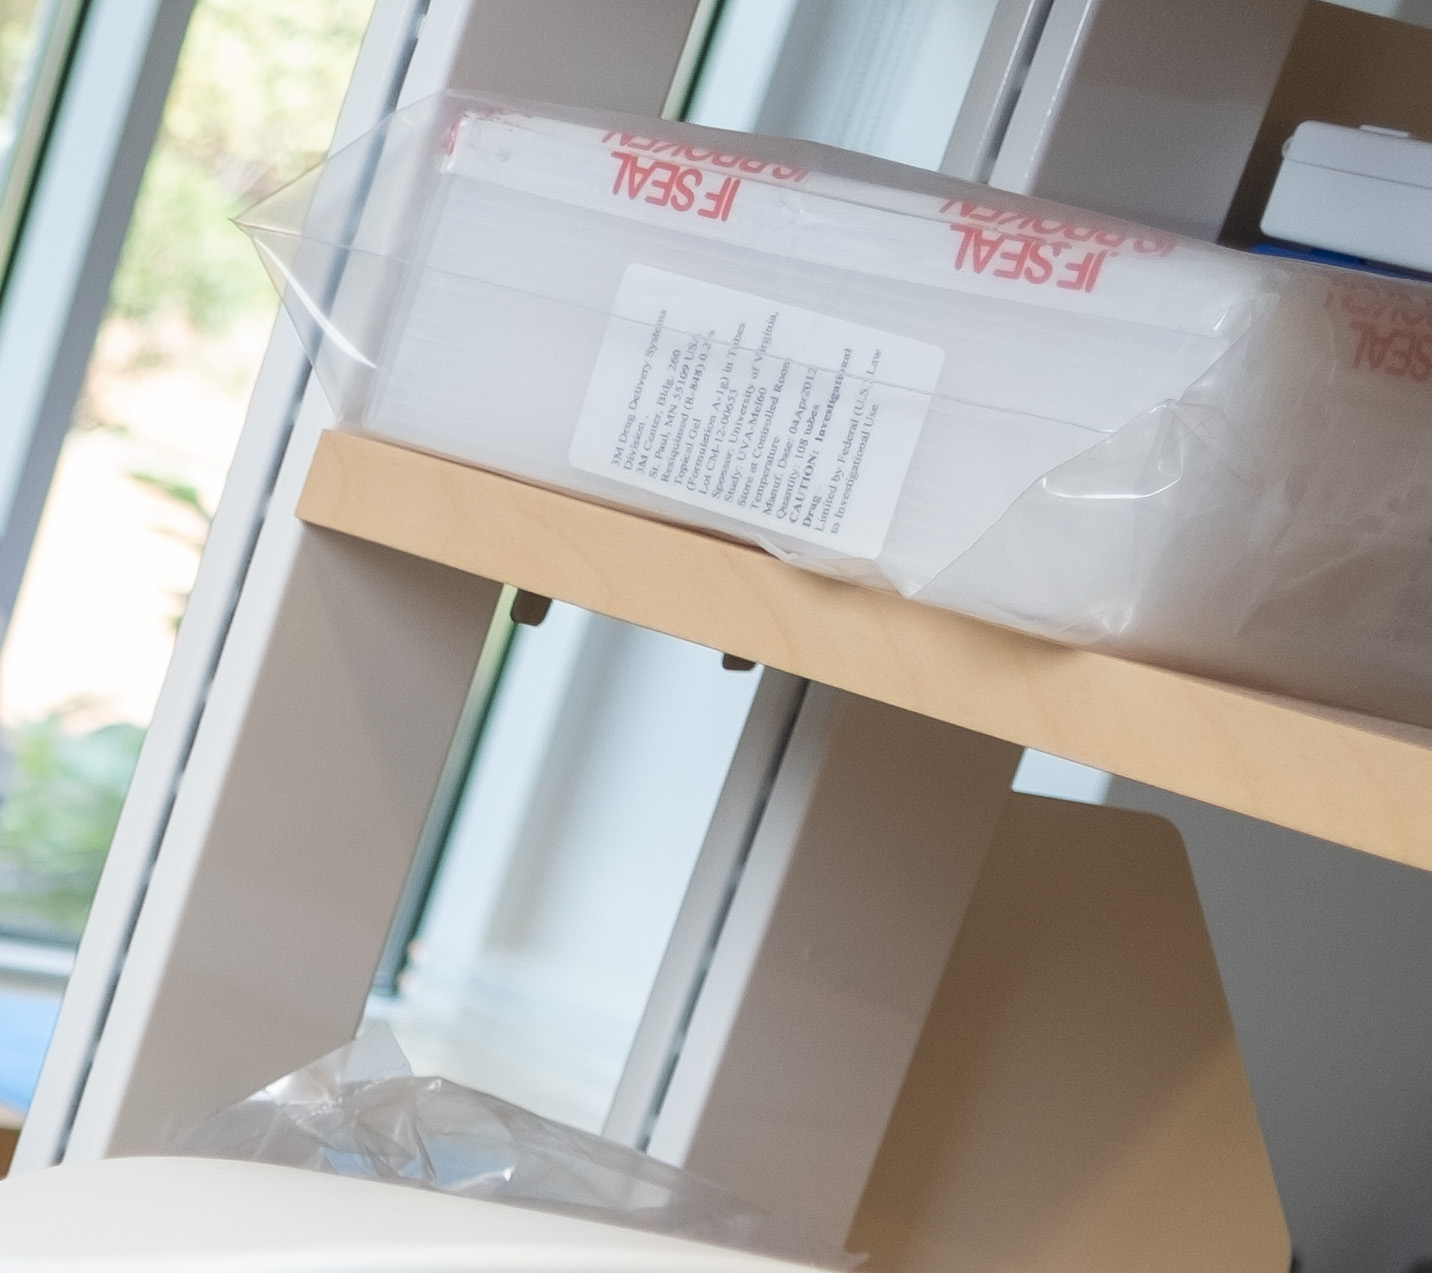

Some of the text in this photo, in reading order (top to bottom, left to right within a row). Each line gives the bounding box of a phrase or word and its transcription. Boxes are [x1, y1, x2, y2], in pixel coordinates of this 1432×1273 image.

[611, 150, 741, 222] IF SEAL
[950, 223, 1117, 293] IF SEAL
[611, 310, 667, 467] 3M Drug Delivery Systems
[866, 349, 881, 374] Law
[636, 454, 649, 475] 3M
[643, 411, 663, 451] Center,
[668, 349, 681, 371] 260
[654, 432, 671, 460] Paul,
[664, 404, 678, 427] MN
[673, 364, 690, 400] 55109
[686, 415, 717, 491] (Formulation
[712, 377, 729, 411] A-1g)
[722, 362, 733, 373] in
[728, 384, 757, 443] University
[751, 365, 760, 379] of
[752, 396, 779, 458] Controlled
[777, 438, 794, 468] Date:
[788, 366, 820, 434] 04Apr2012
[789, 348, 853, 523] CAUTION: Investigational
[674, 418, 701, 485] Topical Gel
[698, 389, 738, 494] Lot CM-12-00653
[749, 462, 758, 473] at
[749, 436, 780, 509] Temperature
[776, 404, 819, 519] Quantity: 108 tubes
[830, 404, 878, 534] to Investigational Use
[831, 467, 844, 482] by
[837, 418, 859, 463] Federal
[724, 466, 743, 503] Study:
[737, 476, 753, 506] Store
[802, 495, 822, 528] Drug
[814, 485, 837, 532] Limited
